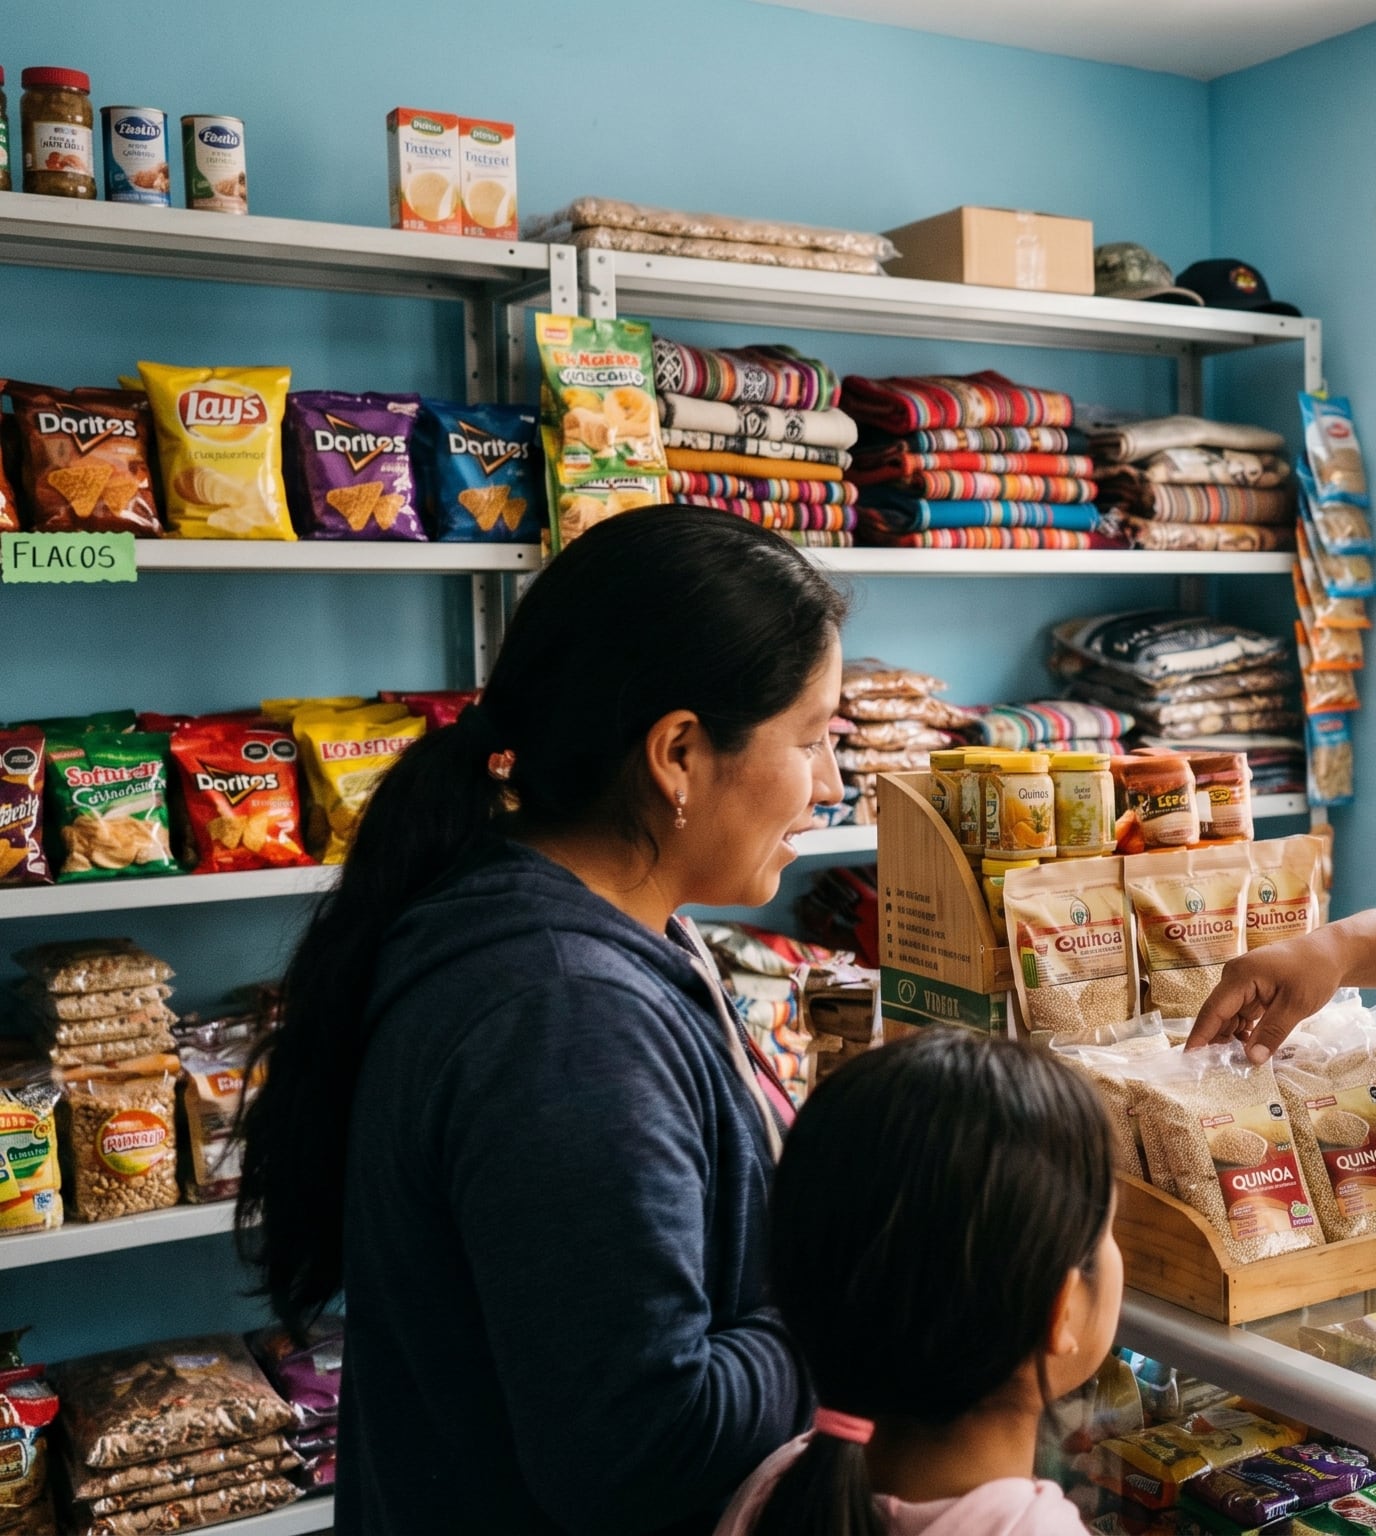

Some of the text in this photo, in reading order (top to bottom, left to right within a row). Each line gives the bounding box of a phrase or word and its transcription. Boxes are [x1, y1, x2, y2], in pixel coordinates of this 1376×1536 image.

[185, 392, 260, 425] Lay's
[38, 412, 137, 437] Doritos
[314, 430, 407, 454] Doritos
[448, 433, 528, 459] Doritos
[12, 540, 116, 569] FLACOS
[196, 772, 279, 792] Doritos
[1164, 918, 1234, 943] Quinoa
[1246, 908, 1308, 930] Quinoa
[1055, 931, 1122, 955] Quinoa
[1232, 1166, 1294, 1191] QUINOA
